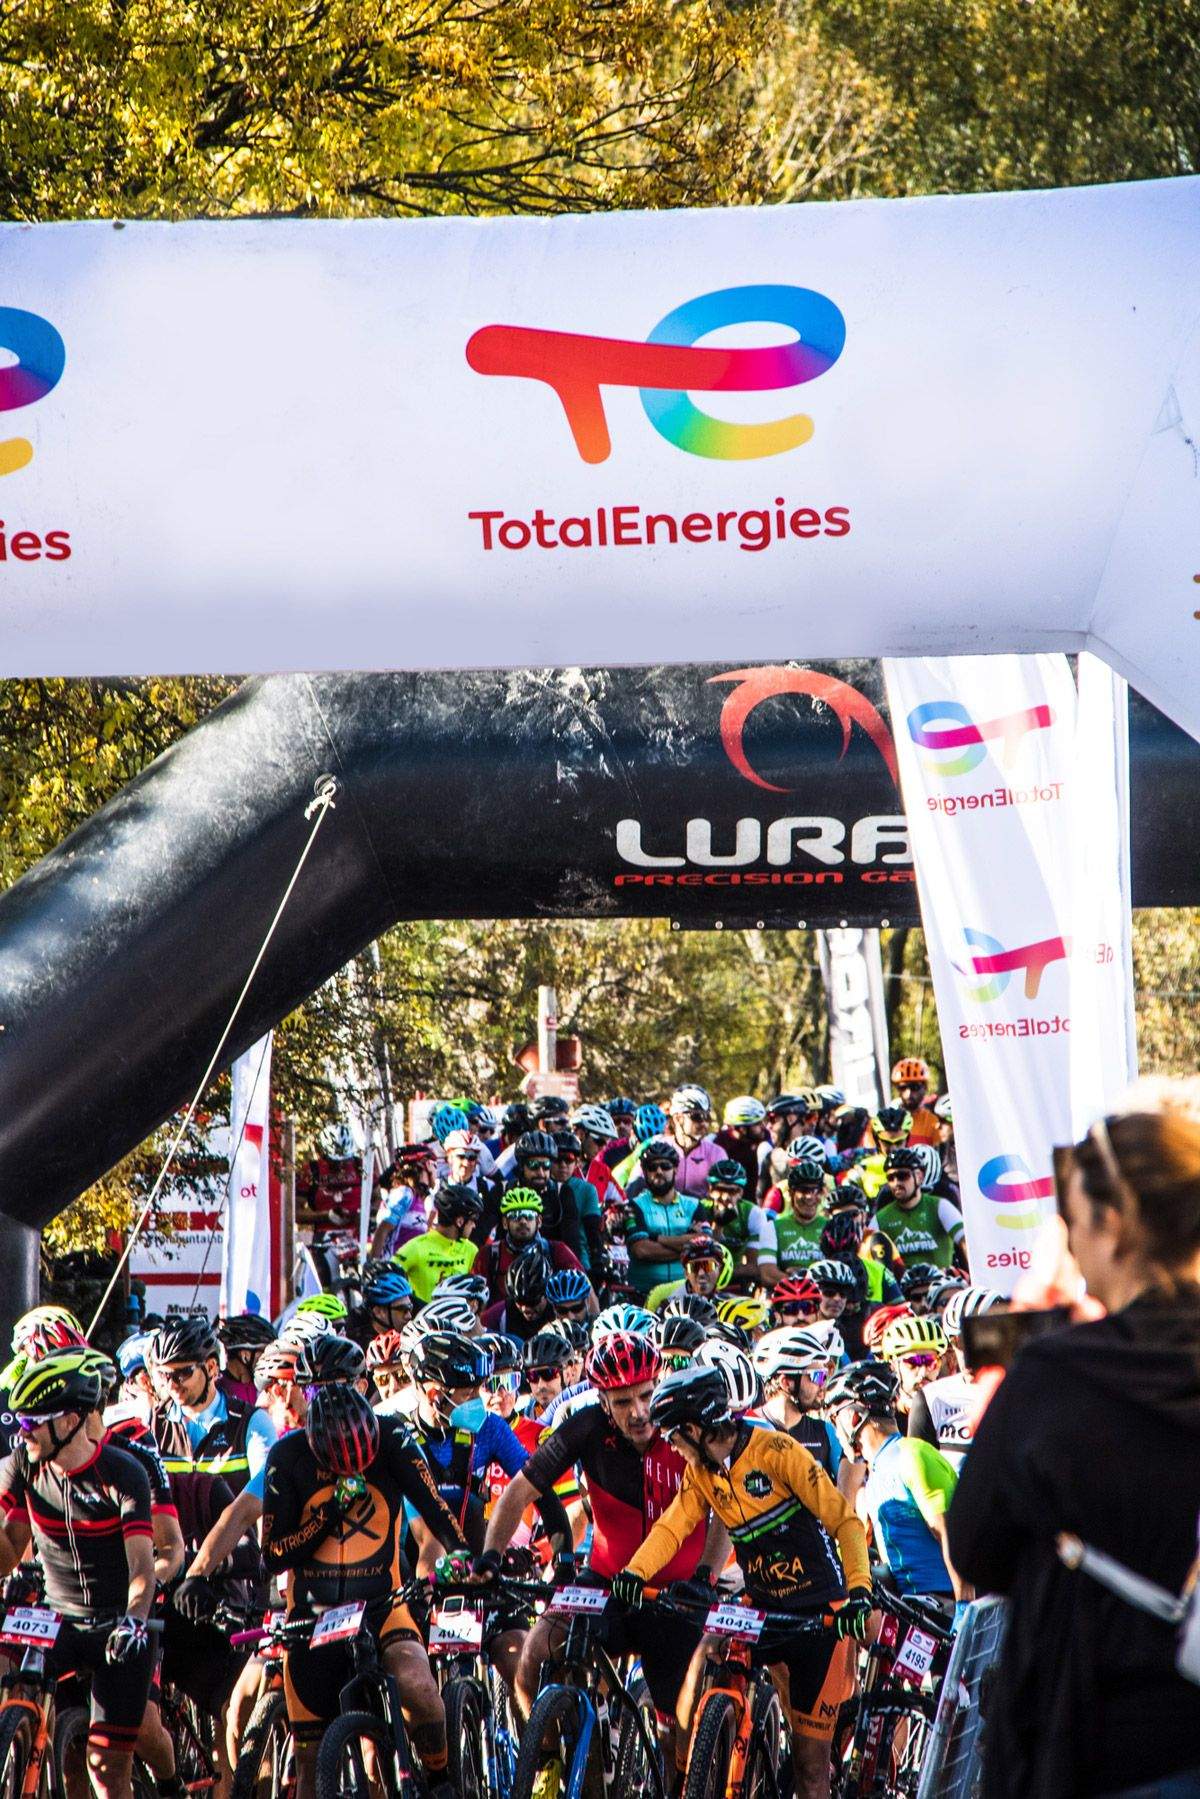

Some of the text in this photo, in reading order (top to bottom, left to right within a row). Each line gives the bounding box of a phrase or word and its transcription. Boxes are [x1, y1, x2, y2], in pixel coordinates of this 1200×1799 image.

[468, 497, 851, 552] TotalEnergies
[167, 1304, 208, 1313] Mundo
[12, 1620, 49, 1634] 4073
[716, 1616, 752, 1631] 4045
[905, 1648, 927, 1671] 4195
